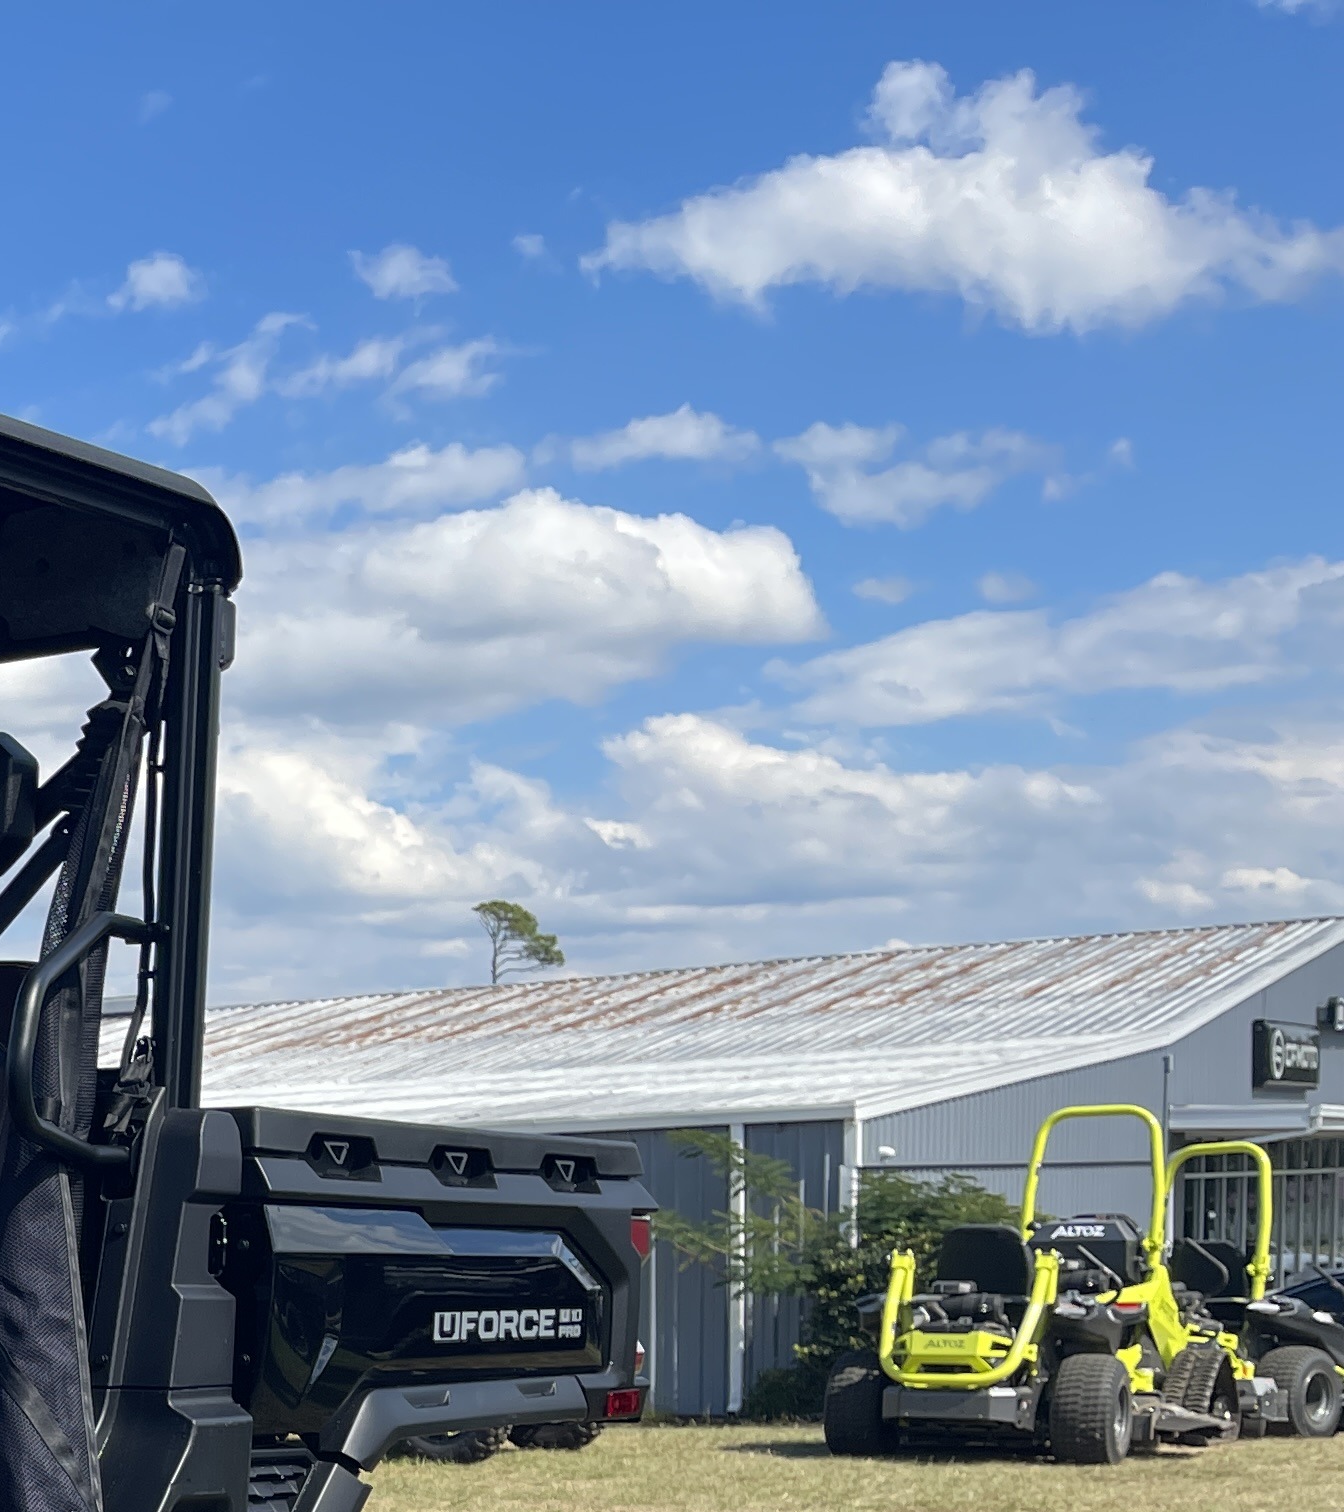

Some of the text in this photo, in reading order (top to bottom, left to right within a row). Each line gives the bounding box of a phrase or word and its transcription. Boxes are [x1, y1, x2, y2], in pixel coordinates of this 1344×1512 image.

[1050, 1225, 1106, 1240] ALTOZ
[432, 1308, 556, 1344] UFORCE
[923, 1339, 966, 1350] ALTOZ
